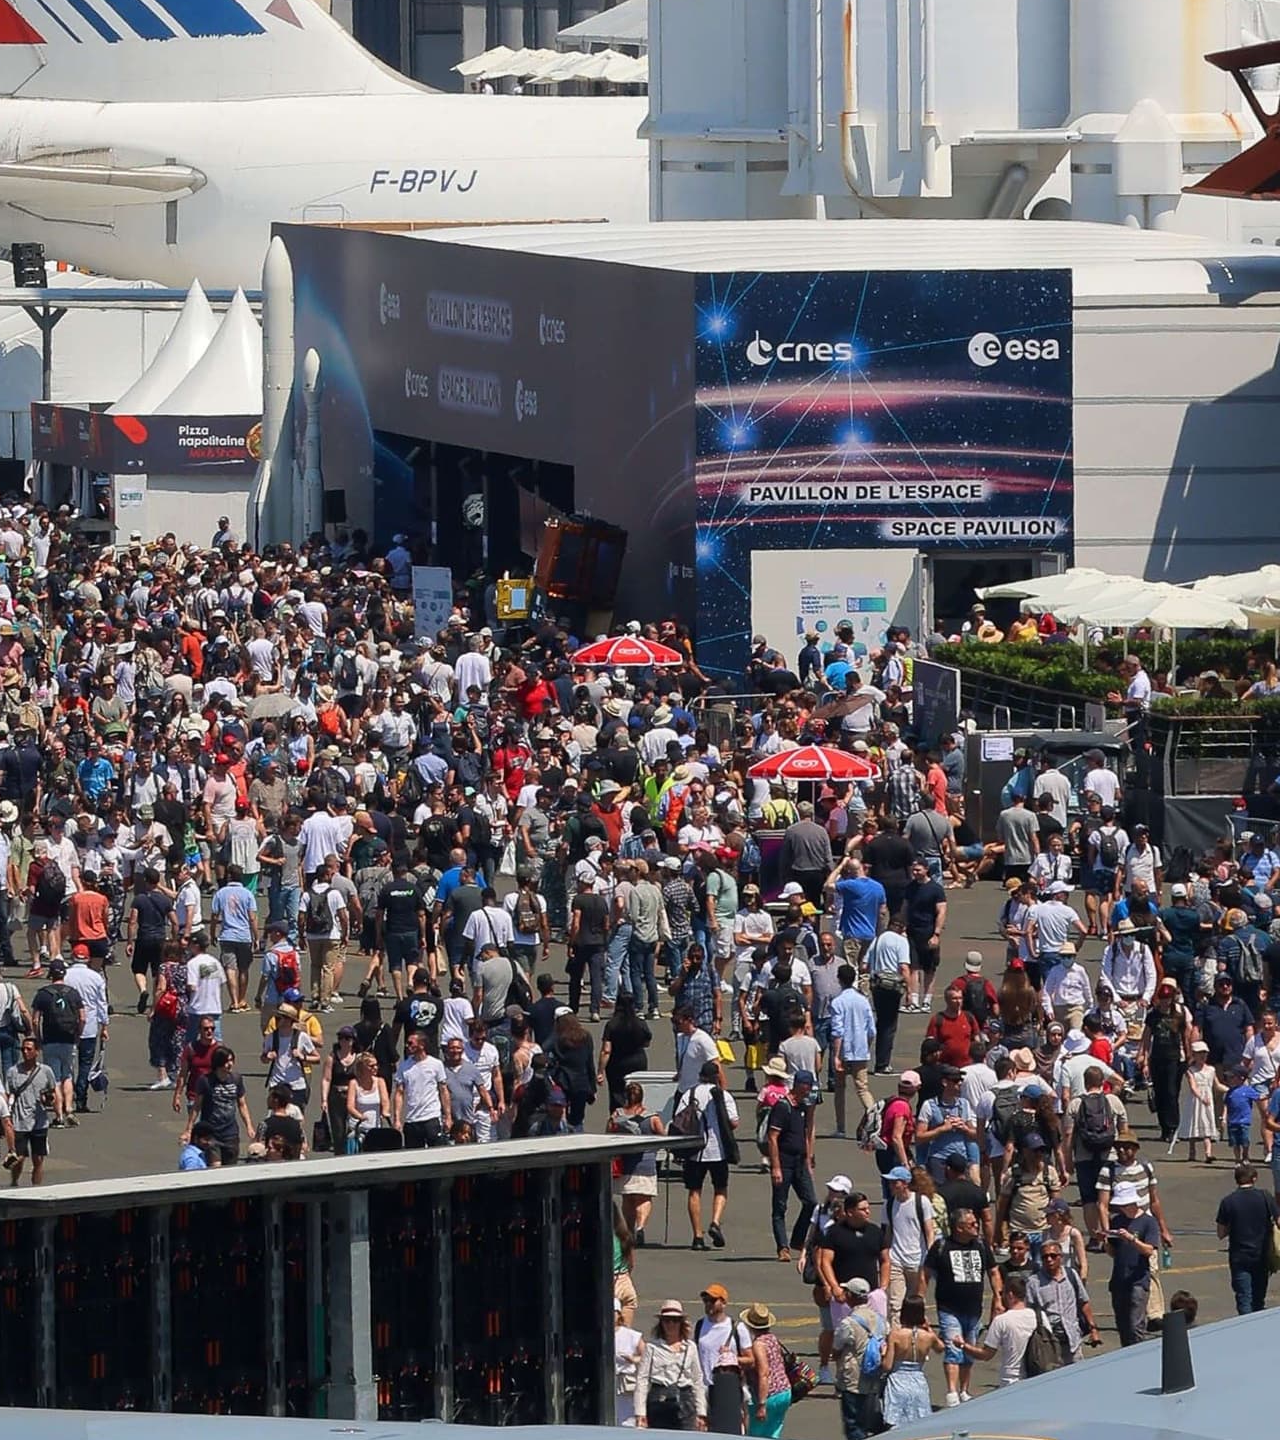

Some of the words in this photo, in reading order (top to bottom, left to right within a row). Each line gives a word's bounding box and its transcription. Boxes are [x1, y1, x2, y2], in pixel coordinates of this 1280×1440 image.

[369, 169, 478, 194] F-BPVJ
[777, 342, 854, 362] cnes
[1004, 337, 1060, 360] esa
[178, 425, 209, 436] Pizza
[178, 435, 245, 448] napolitaine
[749, 485, 848, 502] PAVILLON
[854, 485, 882, 501] DE
[888, 484, 982, 501] L'ESPACE
[891, 520, 957, 537] SPACE
[963, 520, 1057, 536] PAVILION
